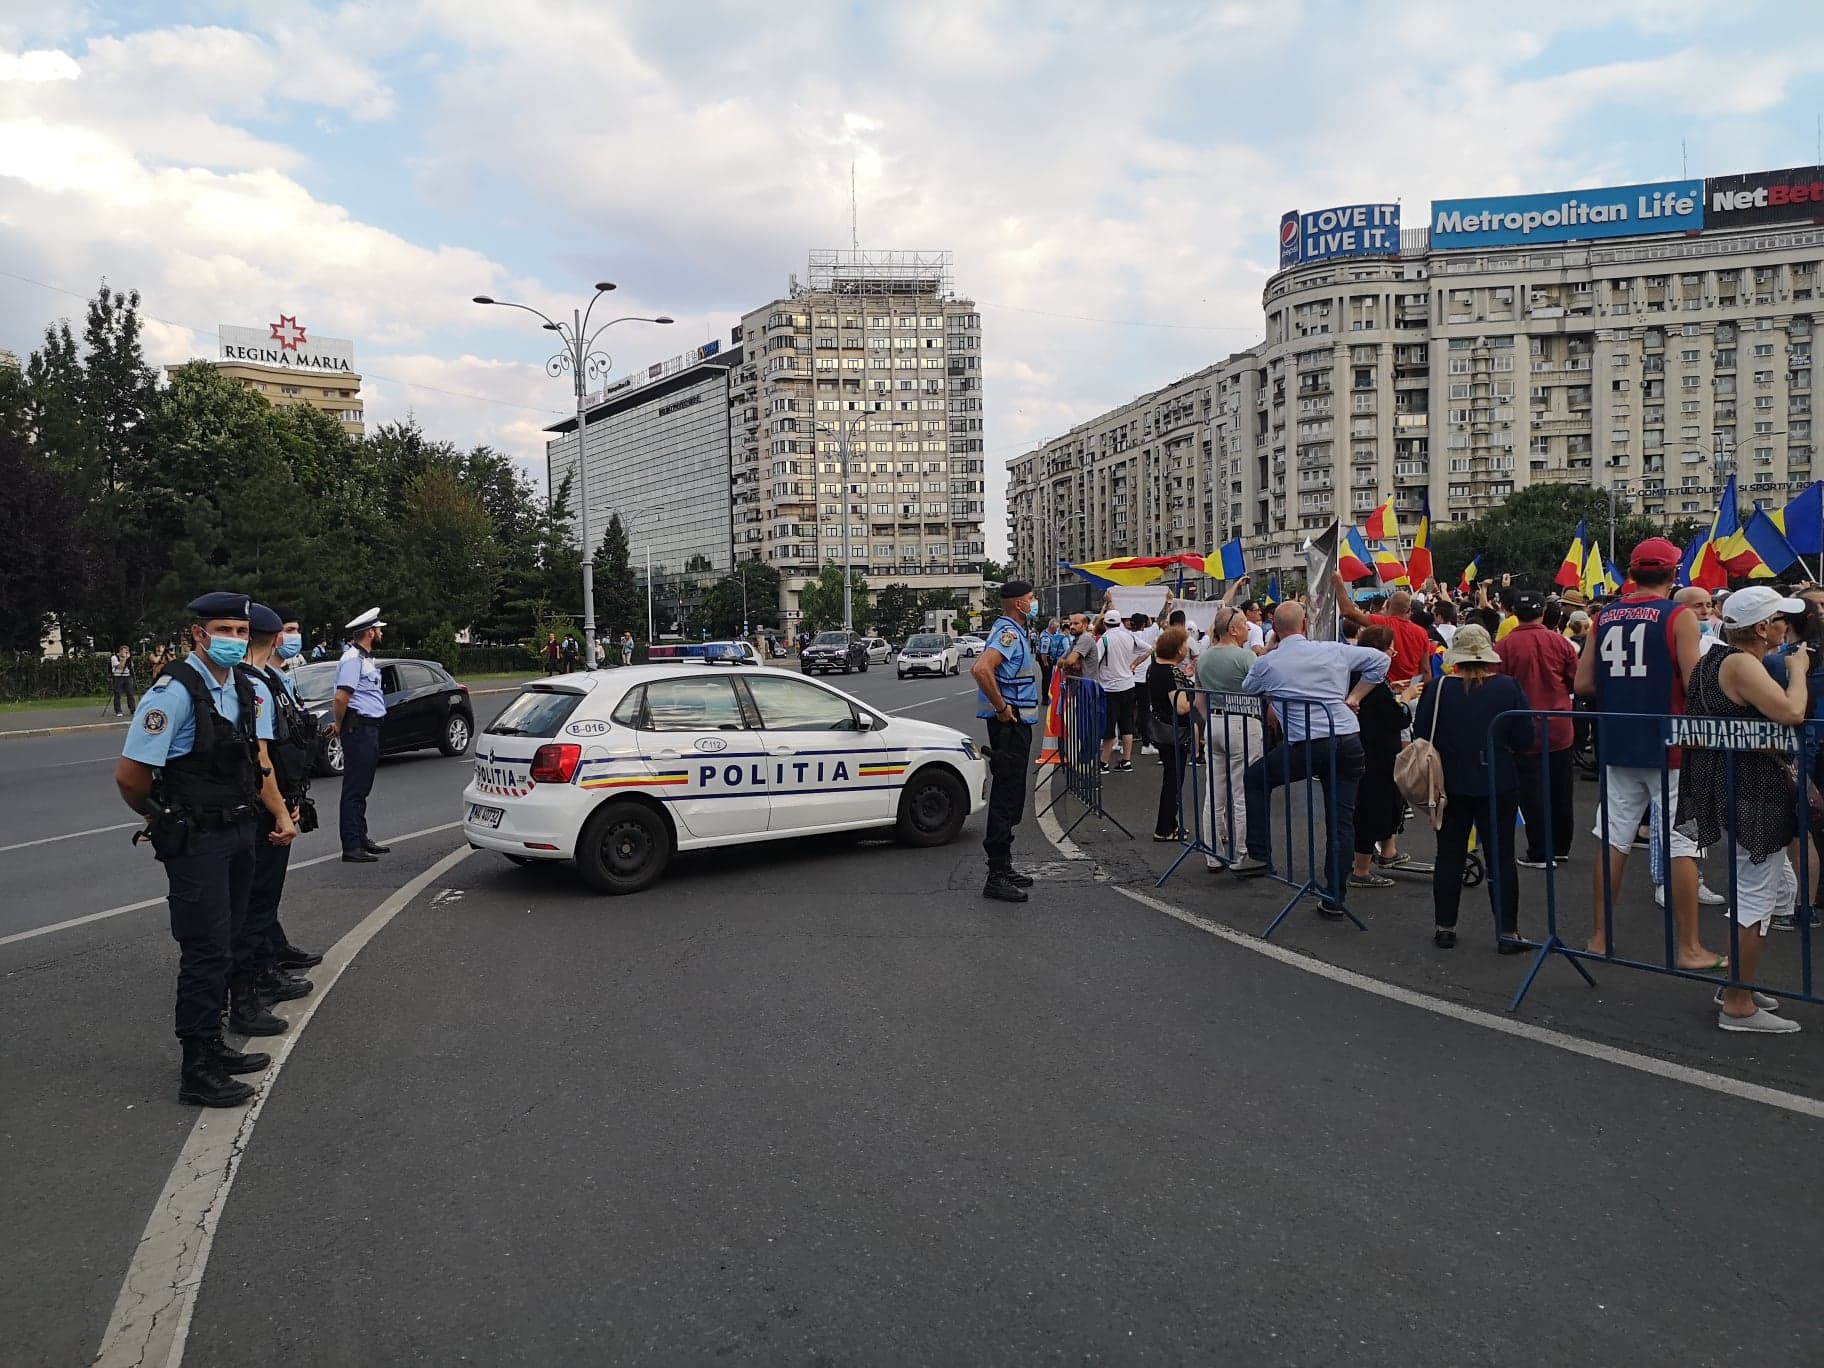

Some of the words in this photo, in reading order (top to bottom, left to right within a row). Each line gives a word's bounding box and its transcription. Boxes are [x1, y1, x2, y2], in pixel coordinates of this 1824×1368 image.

[1713, 181, 1824, 212] NetBet
[1307, 208, 1367, 234] LOVE
[1374, 206, 1400, 226] IT.
[1436, 199, 1628, 234] Metropolitan
[1638, 191, 1695, 219] Life
[1307, 231, 1356, 257] LIVE
[1363, 229, 1391, 248] IT.
[225, 345, 290, 364] REGINA
[296, 353, 350, 371] MARIA
[1638, 486, 1693, 497] COMITETUL
[1750, 482, 1792, 492] SPORTIV
[1598, 607, 1660, 626] CAPTAIN
[1600, 622, 1647, 677] 41
[572, 723, 605, 734] B-016
[1665, 718, 1800, 751] JANDARMERIA
[709, 741, 721, 749] 112
[700, 761, 849, 787] POLITIA
